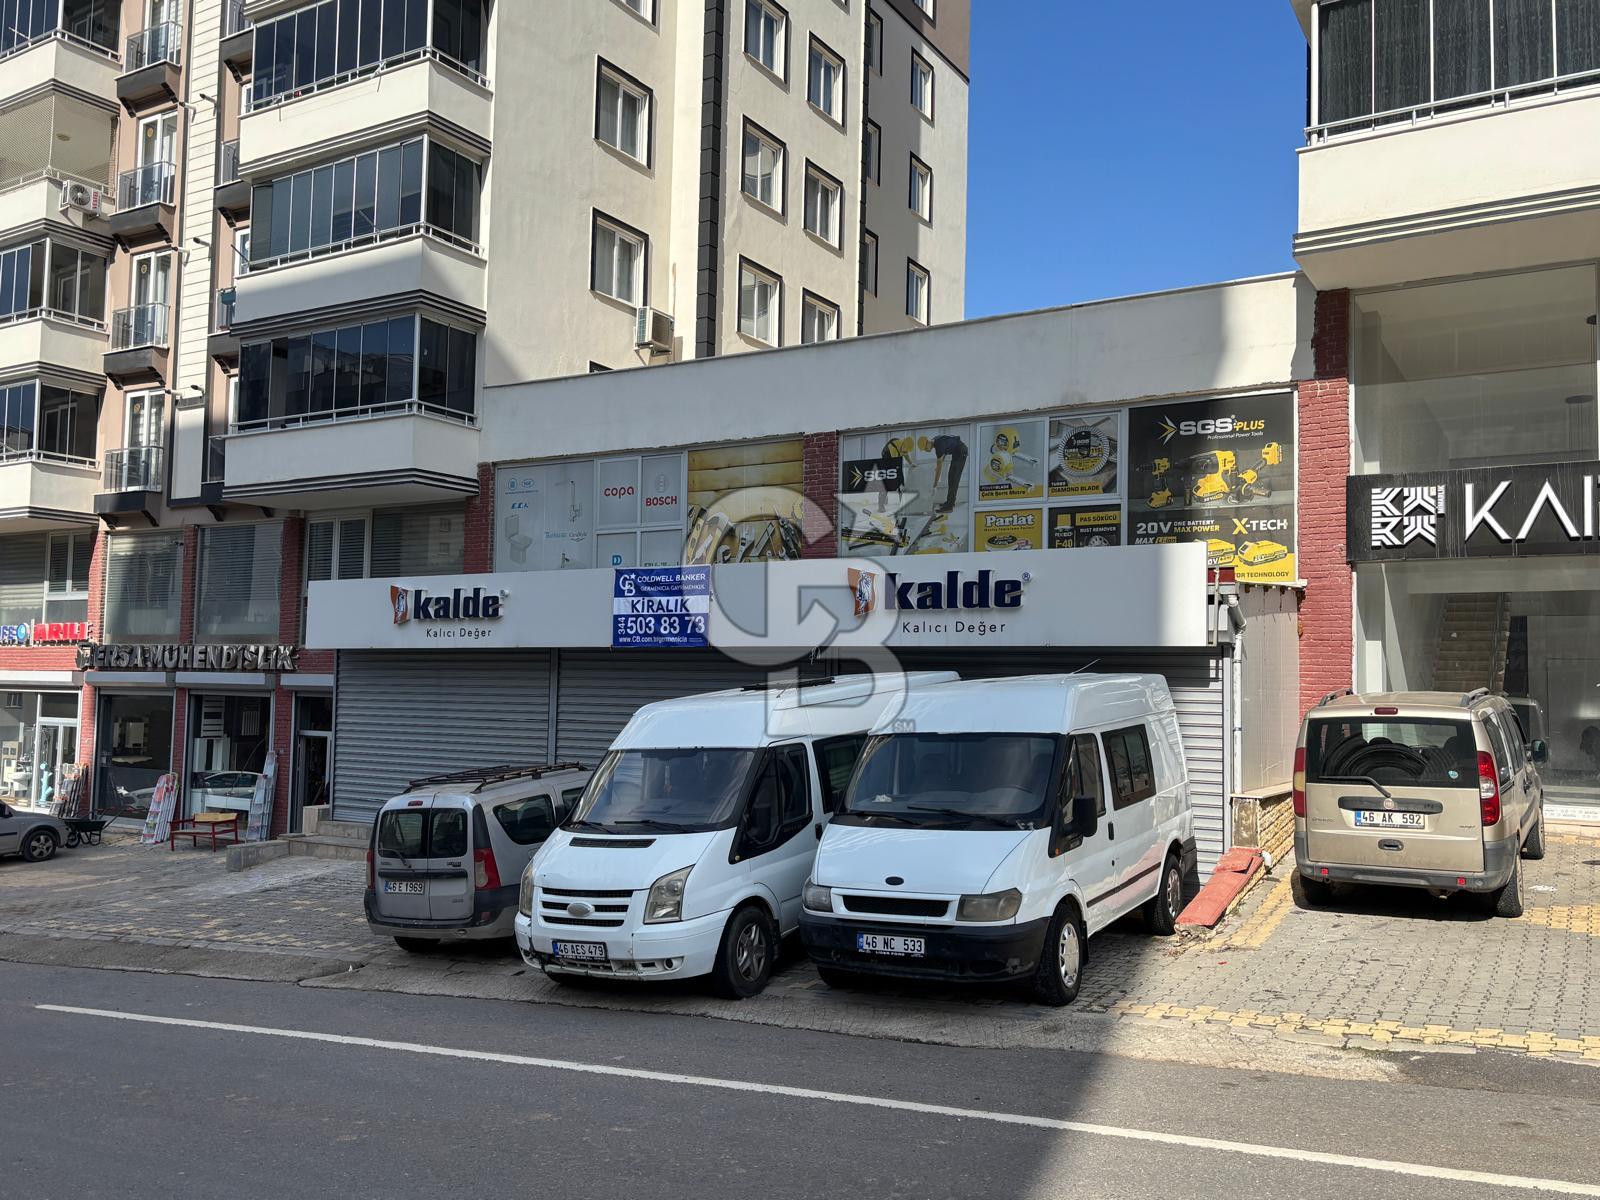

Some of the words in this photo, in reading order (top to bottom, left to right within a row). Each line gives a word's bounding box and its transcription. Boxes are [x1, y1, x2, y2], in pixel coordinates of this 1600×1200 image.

[1179, 418, 1233, 436] SGS
[864, 468, 898, 481] SGS
[604, 486, 635, 499] copa
[645, 496, 678, 507] BOSCH
[985, 512, 1036, 527] Parlat
[1232, 517, 1288, 535] X-TECH
[1136, 521, 1172, 535] 20V
[1192, 525, 1220, 533] POWER
[1134, 536, 1155, 545] MAX
[637, 575, 674, 583] COLDWELL
[675, 573, 706, 582] BANKER
[884, 569, 1023, 610] kalde
[413, 587, 501, 620] kalde
[631, 597, 690, 613] KİRALIK
[626, 616, 655, 635] 503
[660, 616, 680, 635] 83
[684, 615, 706, 634] 73
[902, 621, 948, 633] Kalıcı
[955, 620, 1006, 636] Değer
[426, 628, 456, 638] Kalıcı
[459, 627, 492, 639] Değer
[1362, 811, 1375, 822] 46
[1381, 812, 1394, 823] AK
[1402, 813, 1422, 825] 592
[388, 882, 397, 892] 46
[398, 883, 403, 892] E
[405, 882, 423, 893] 1969
[558, 943, 569, 954] 46
[570, 944, 586, 955] AES
[587, 945, 604, 956] 479
[865, 936, 877, 949] 46
[883, 937, 895, 950] NC
[903, 938, 922, 952] 533
